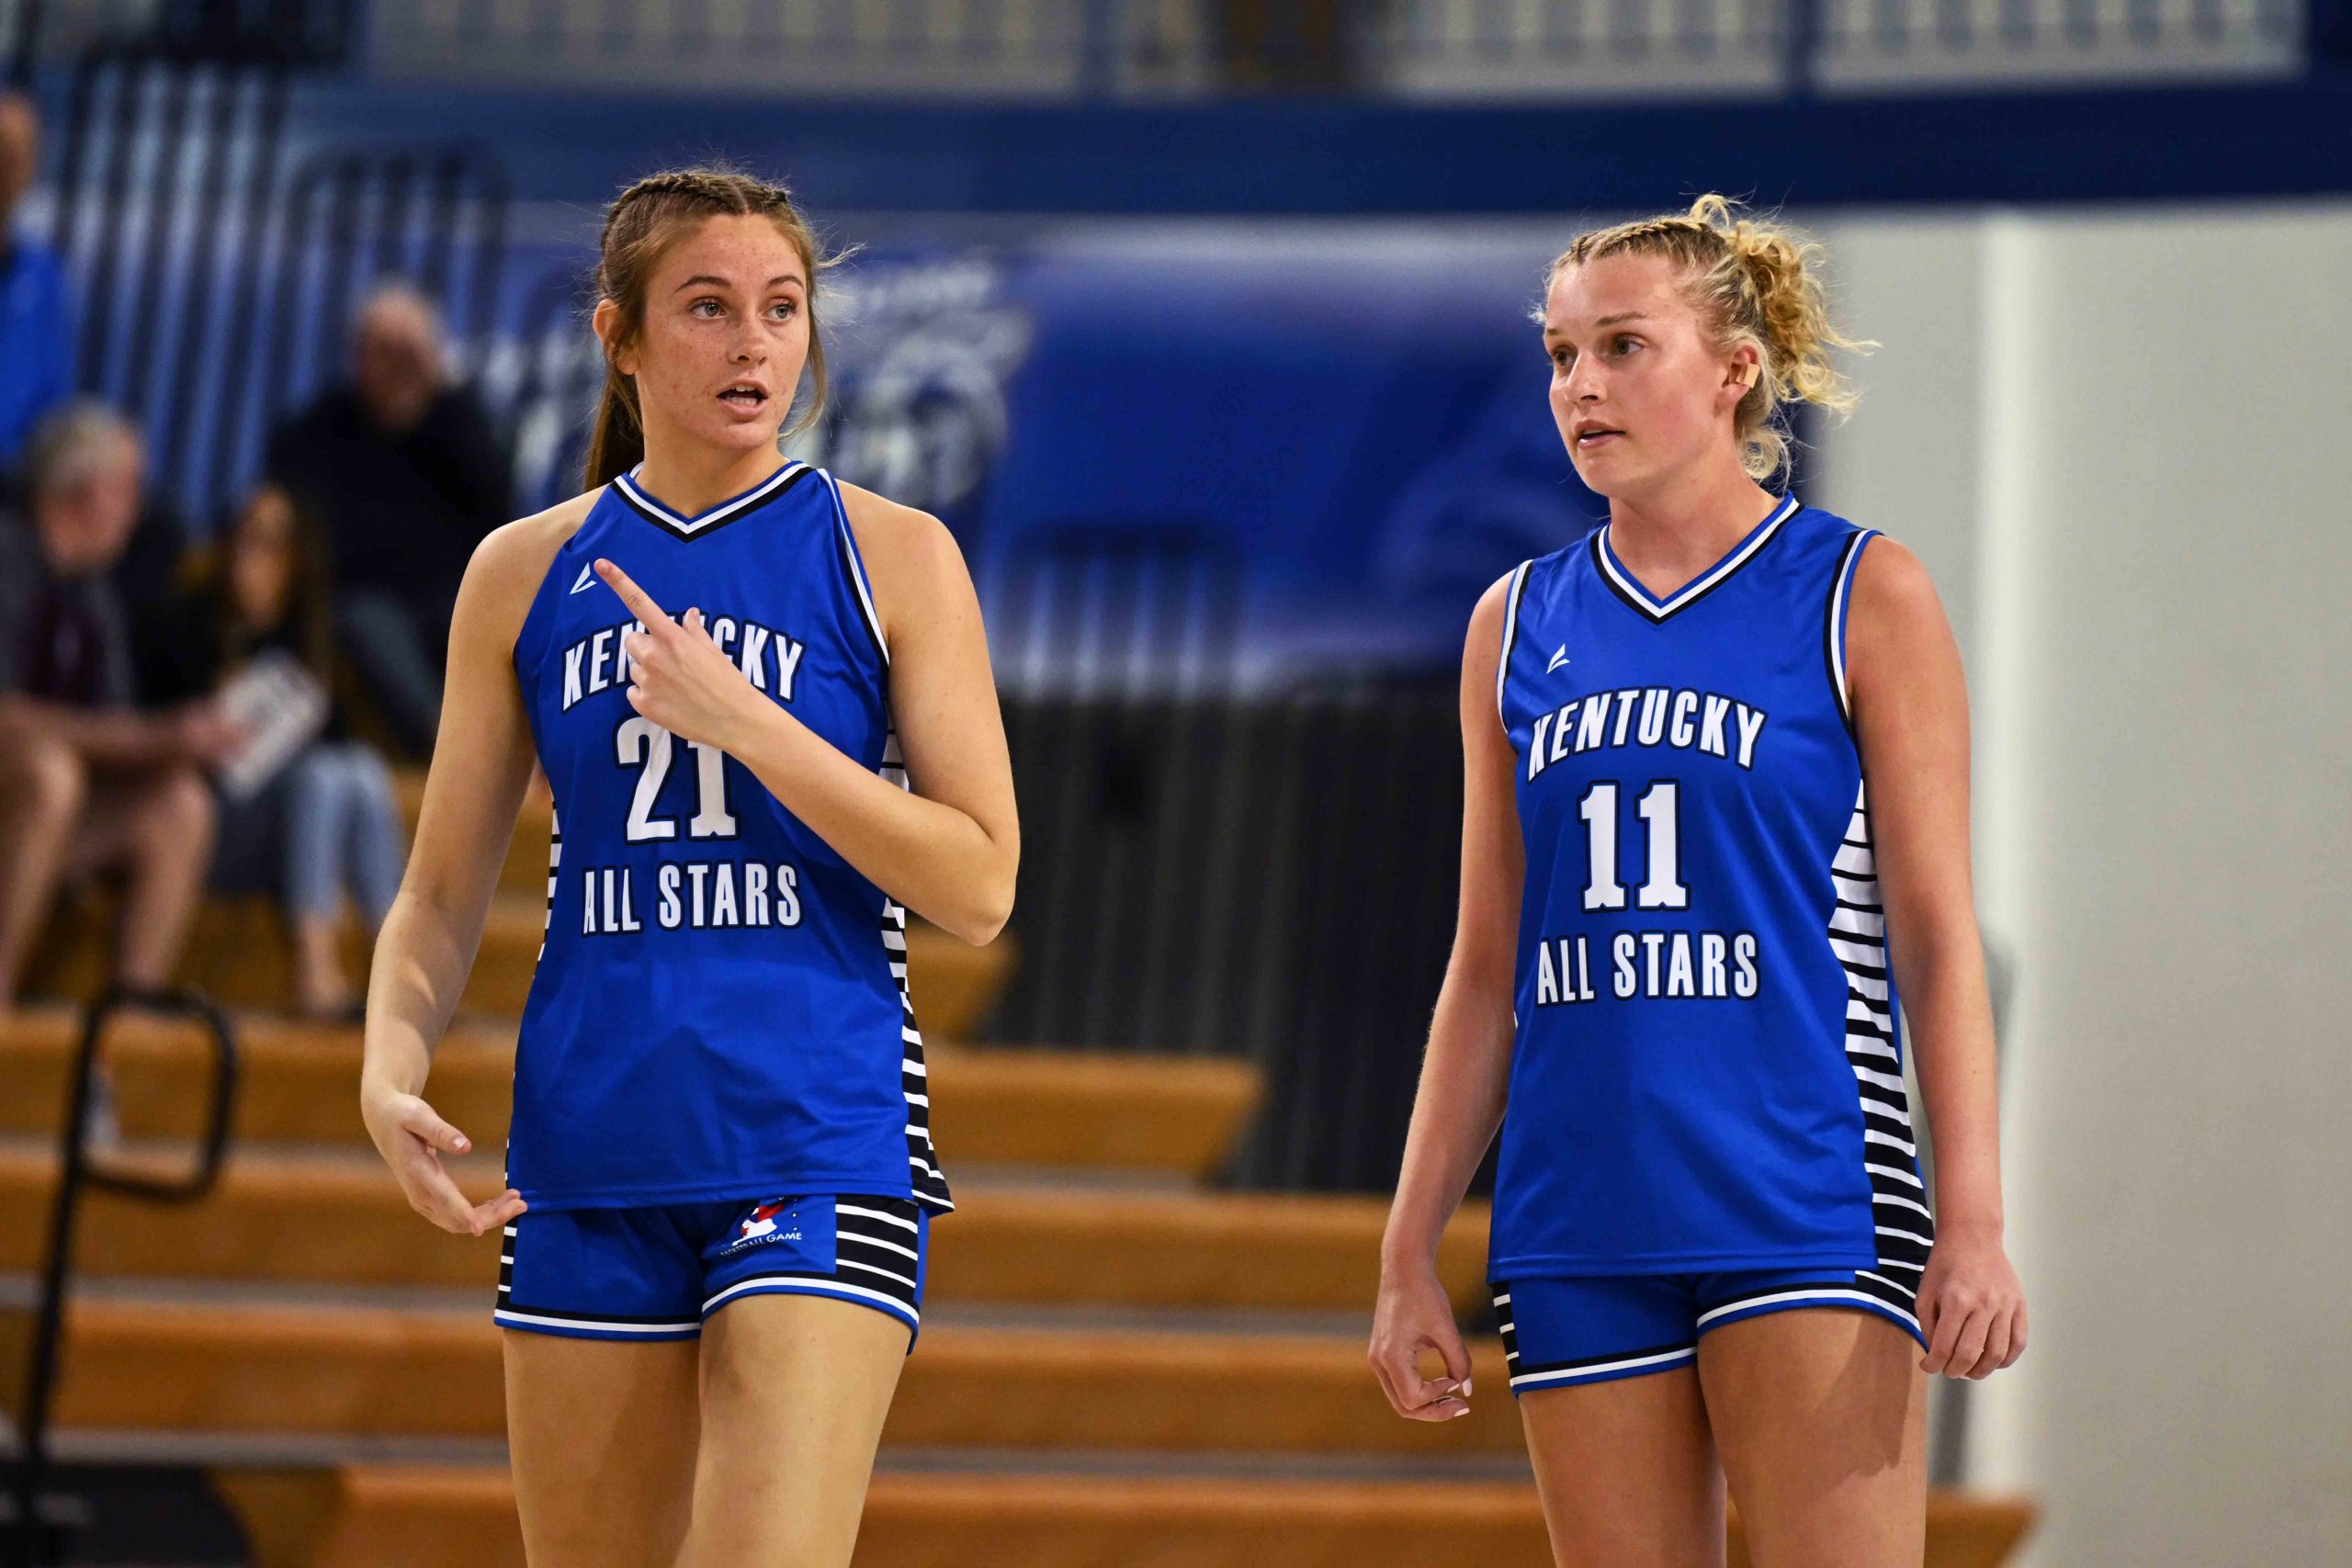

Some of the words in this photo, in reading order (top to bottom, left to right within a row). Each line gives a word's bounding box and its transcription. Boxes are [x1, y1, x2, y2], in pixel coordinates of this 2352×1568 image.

[562, 615, 803, 713] KENCKY
[616, 716, 737, 841] 21
[1527, 688, 1767, 782] KENTUCKY
[1580, 783, 1688, 910] 11
[582, 866, 641, 935] ALL
[659, 862, 801, 929] STARS
[1536, 936, 1595, 1005] ALL
[1612, 932, 1758, 998] STARS
[766, 1232, 802, 1243] GAME
